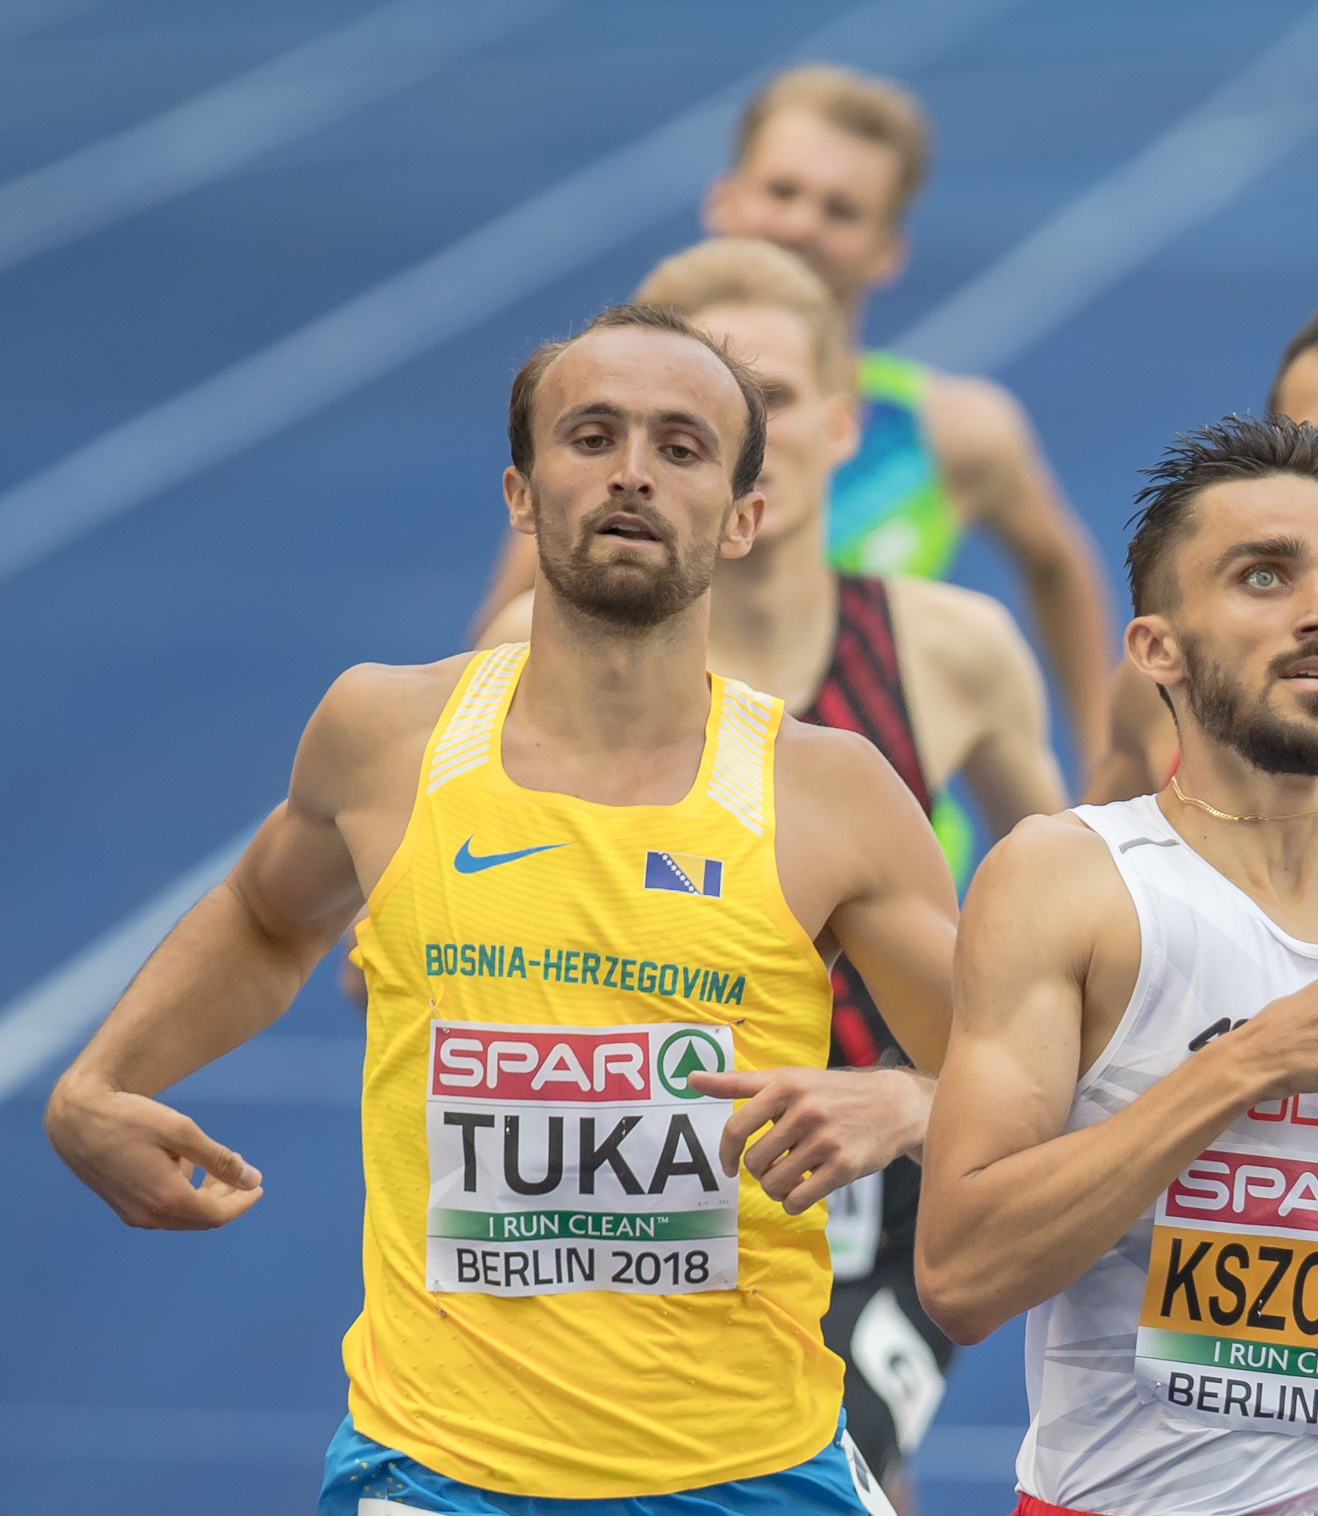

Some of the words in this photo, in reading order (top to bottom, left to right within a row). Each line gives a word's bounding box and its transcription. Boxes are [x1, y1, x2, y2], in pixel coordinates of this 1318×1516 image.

[425, 943, 746, 1005] BOSNIA-HERZEGOVINA
[438, 1037, 645, 1093] SPAR
[443, 1112, 720, 1196] TUKA
[488, 1215, 496, 1238] I
[502, 1214, 560, 1238] RUN
[456, 1246, 596, 1288] BERLIN
[611, 1249, 711, 1286] 2018
[1213, 1341, 1222, 1362] I
[1228, 1343, 1290, 1371] RUN
